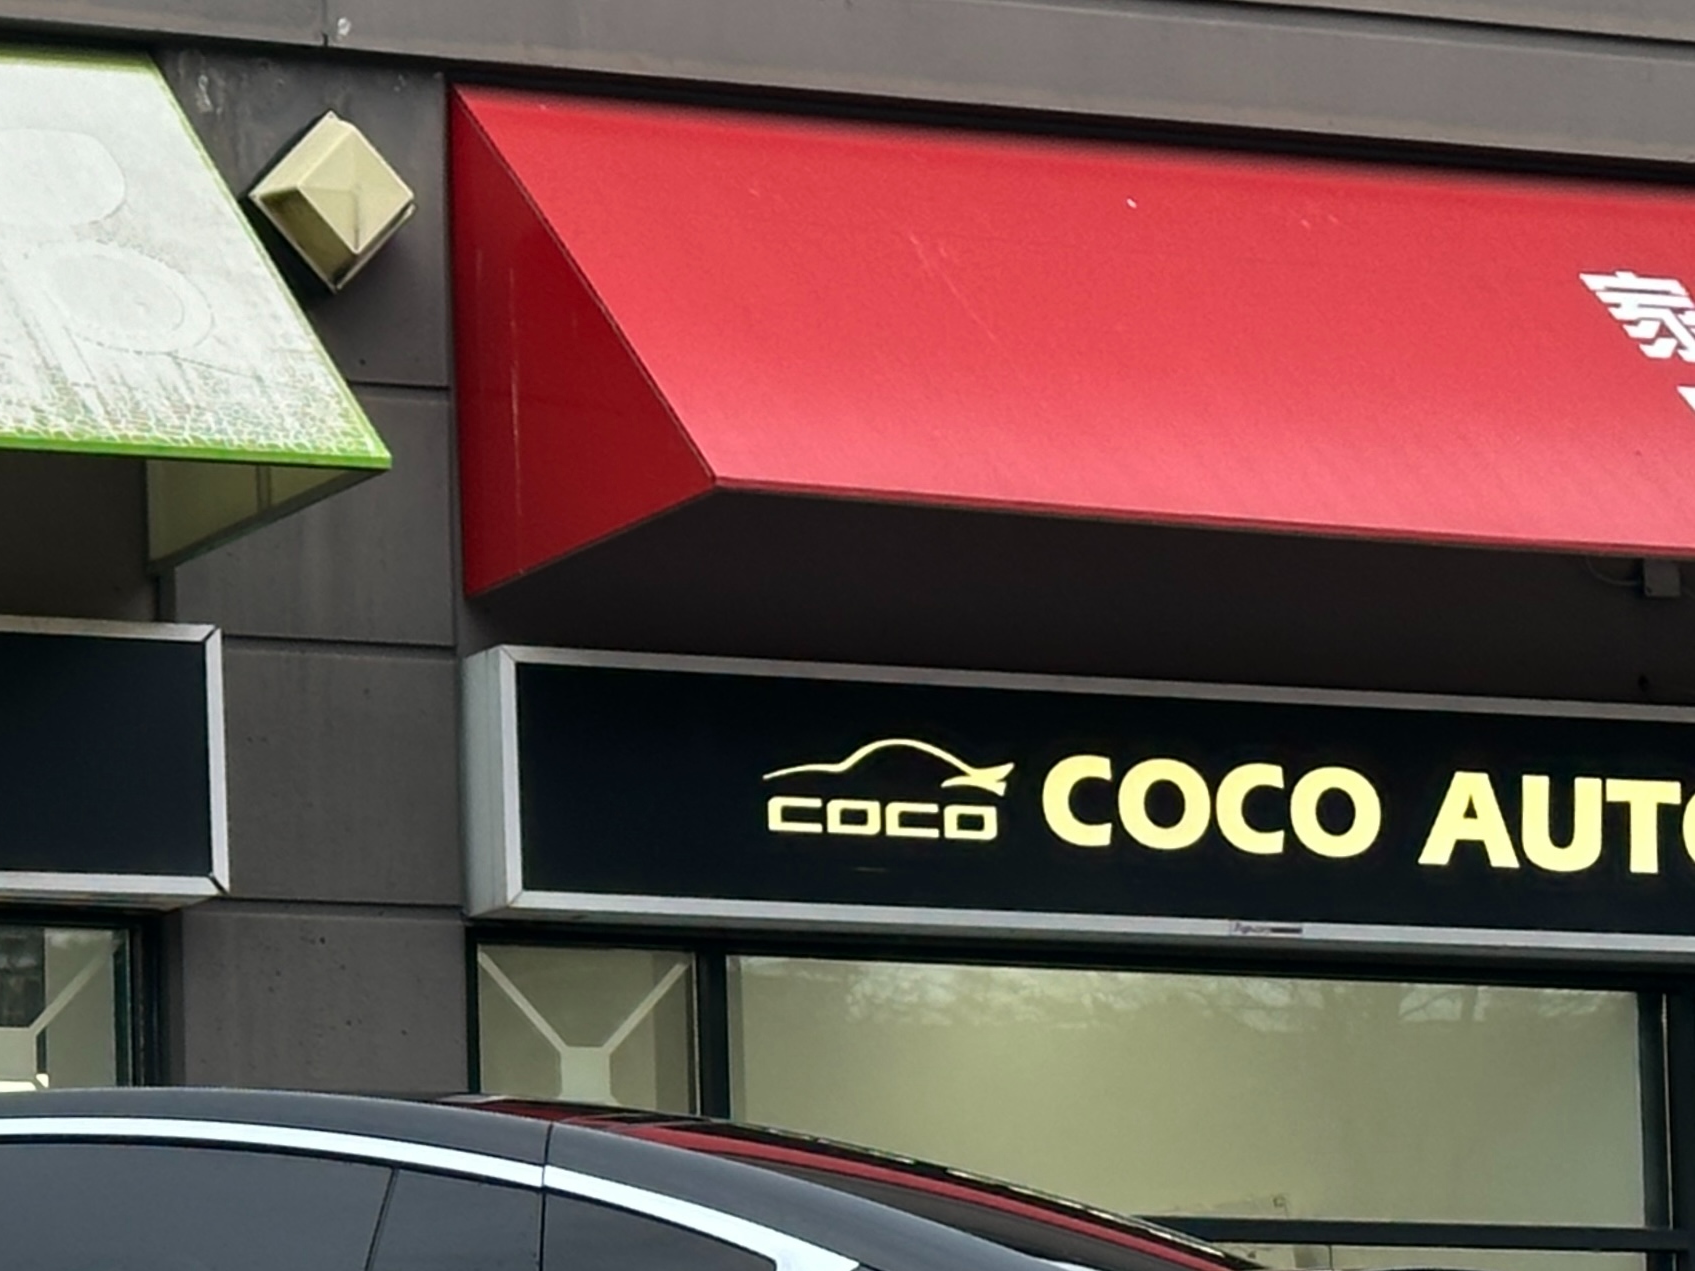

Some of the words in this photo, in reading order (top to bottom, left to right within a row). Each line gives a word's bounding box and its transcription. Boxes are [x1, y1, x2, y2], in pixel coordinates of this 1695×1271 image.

[767, 797, 998, 841] COCO
[1043, 755, 1382, 858] COCO
[1418, 771, 1695, 874] AUT
